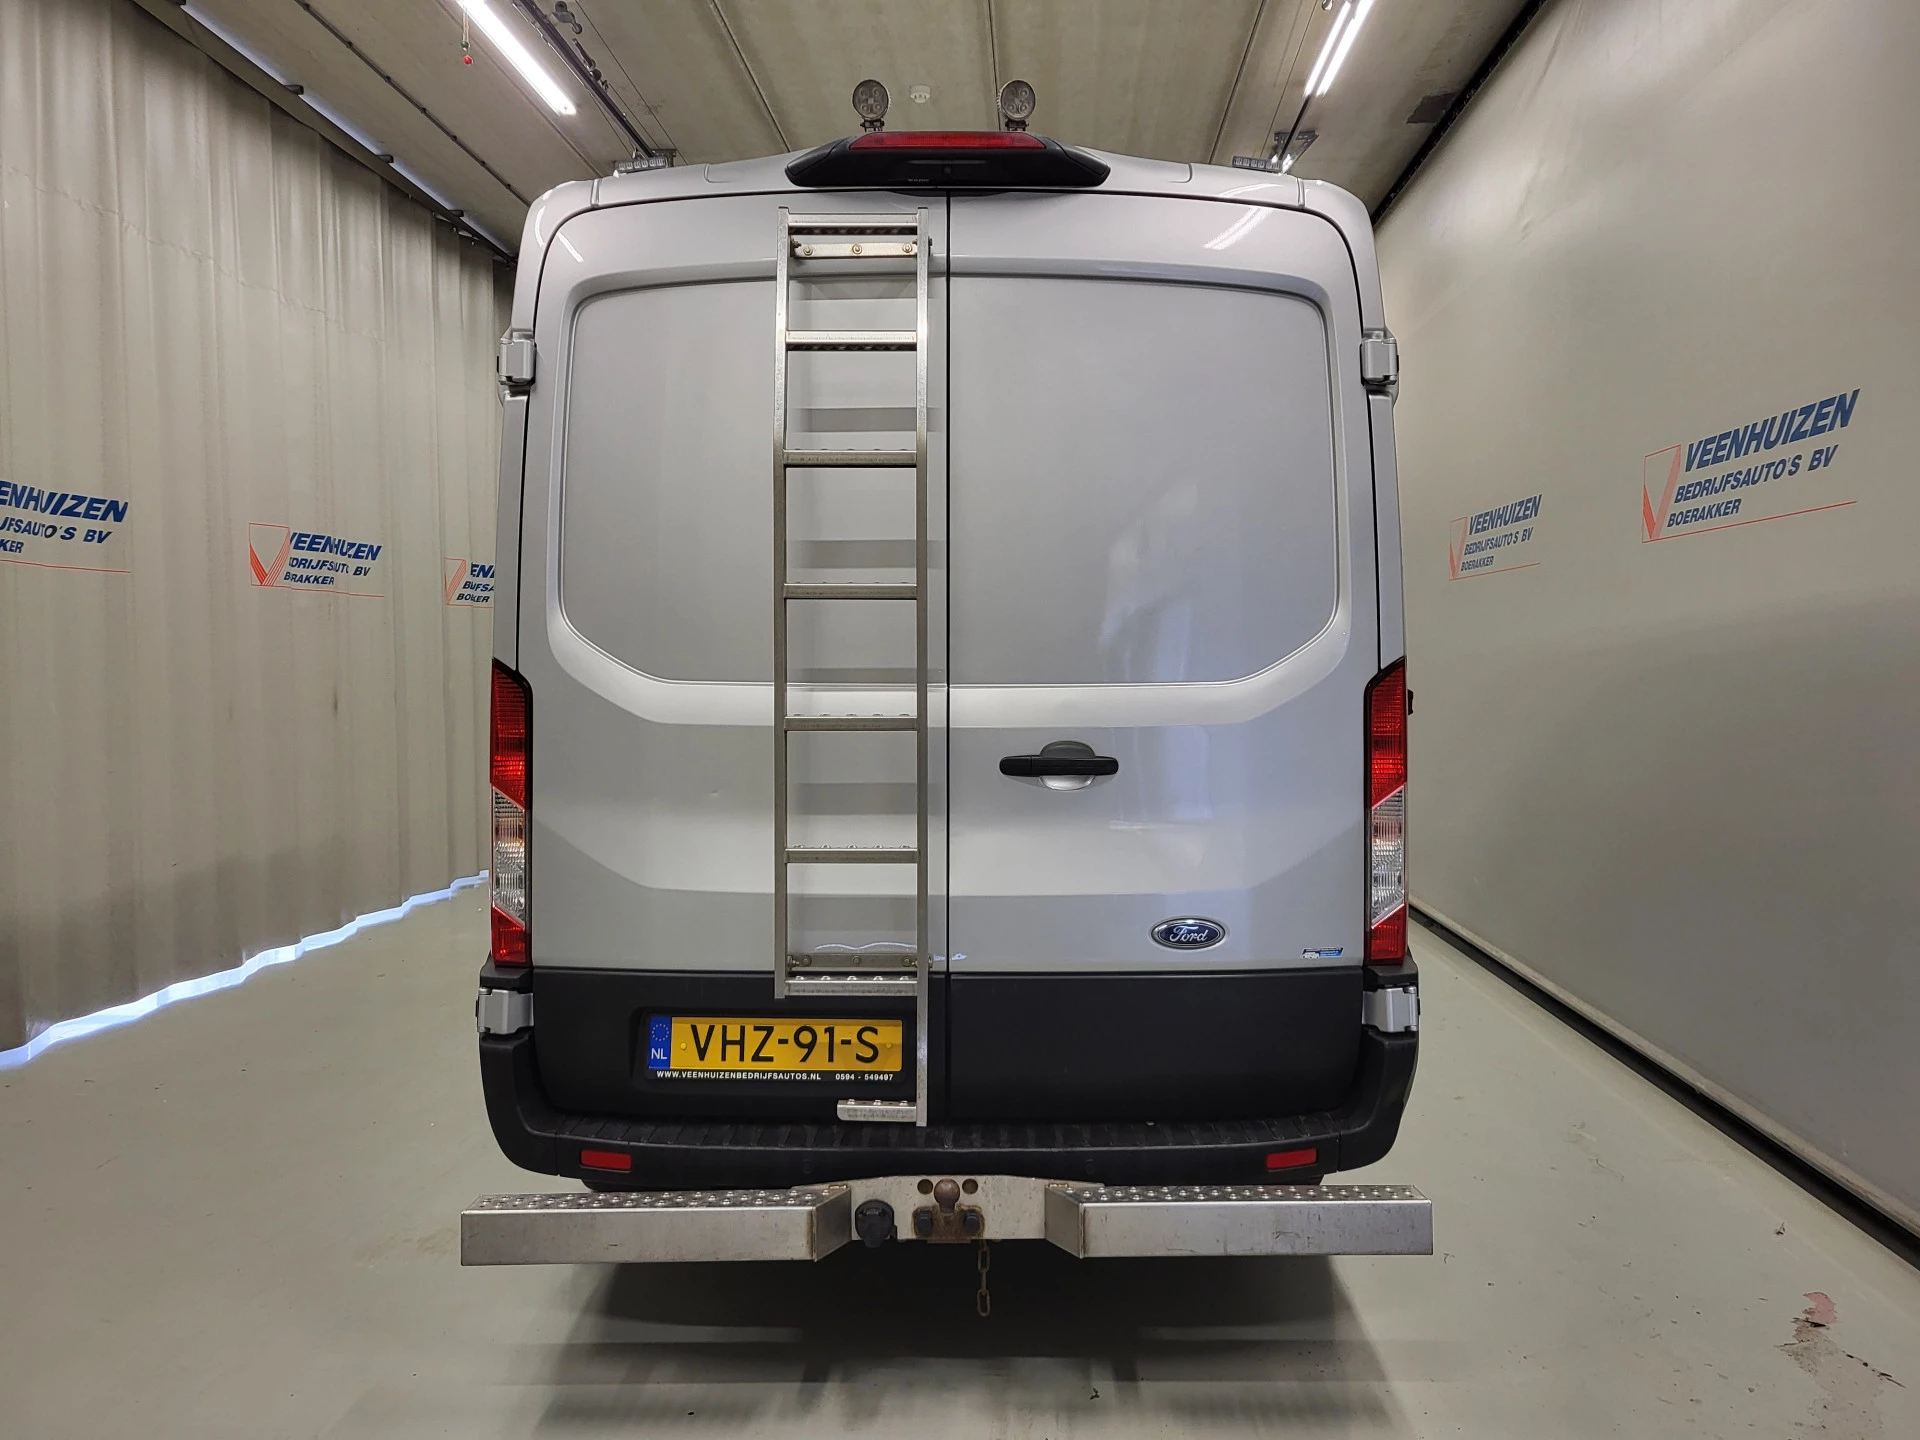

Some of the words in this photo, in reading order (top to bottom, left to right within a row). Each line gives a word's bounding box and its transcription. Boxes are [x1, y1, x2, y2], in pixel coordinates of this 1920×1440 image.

[1685, 388, 1861, 473] VEENHUIZEN
[1674, 454, 1803, 504] BEDRIJFSAUTO'S
[1807, 444, 1839, 472] BV
[1468, 493, 1543, 536] VEENHUIZEN
[1667, 498, 1742, 528] BOERAKKER
[82, 529, 113, 544] BV
[1464, 530, 1519, 556] BEDRIJFSAUTO'S
[1520, 526, 1534, 543] BV
[353, 565, 371, 577] BV
[1460, 555, 1494, 572] BOERAKKER
[1169, 925, 1209, 942] Ford
[651, 1047, 668, 1060] NL
[690, 1024, 879, 1064] VHZ-91-S
[656, 1070, 822, 1081] WWW.VEENHUIZENBEDRIJFSAUTOS.NL
[835, 1073, 855, 1081] 0594
